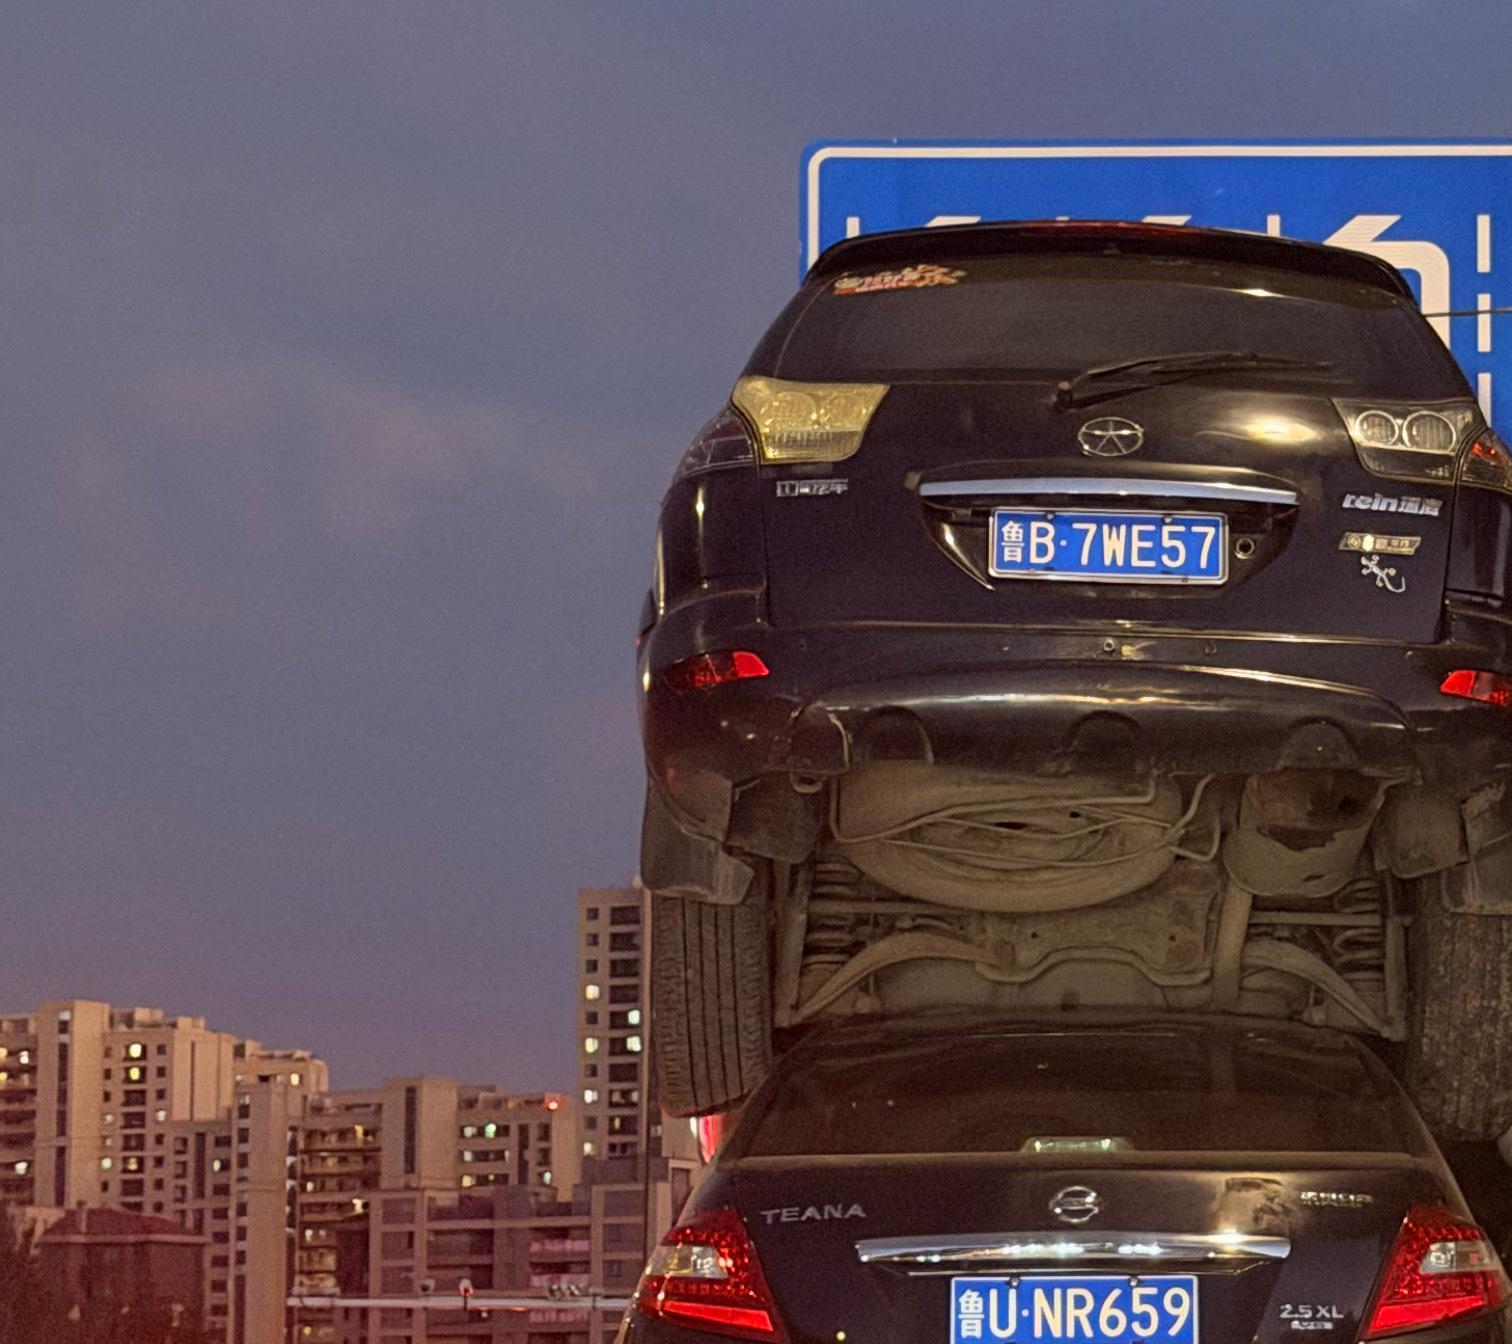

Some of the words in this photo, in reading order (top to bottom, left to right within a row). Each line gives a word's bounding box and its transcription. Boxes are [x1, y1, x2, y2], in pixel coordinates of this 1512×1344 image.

[1001, 520, 1216, 569] 鲁B·7WE57
[760, 1204, 867, 1225] TEANA
[958, 1286, 1191, 1339] 鲁U·NR659
